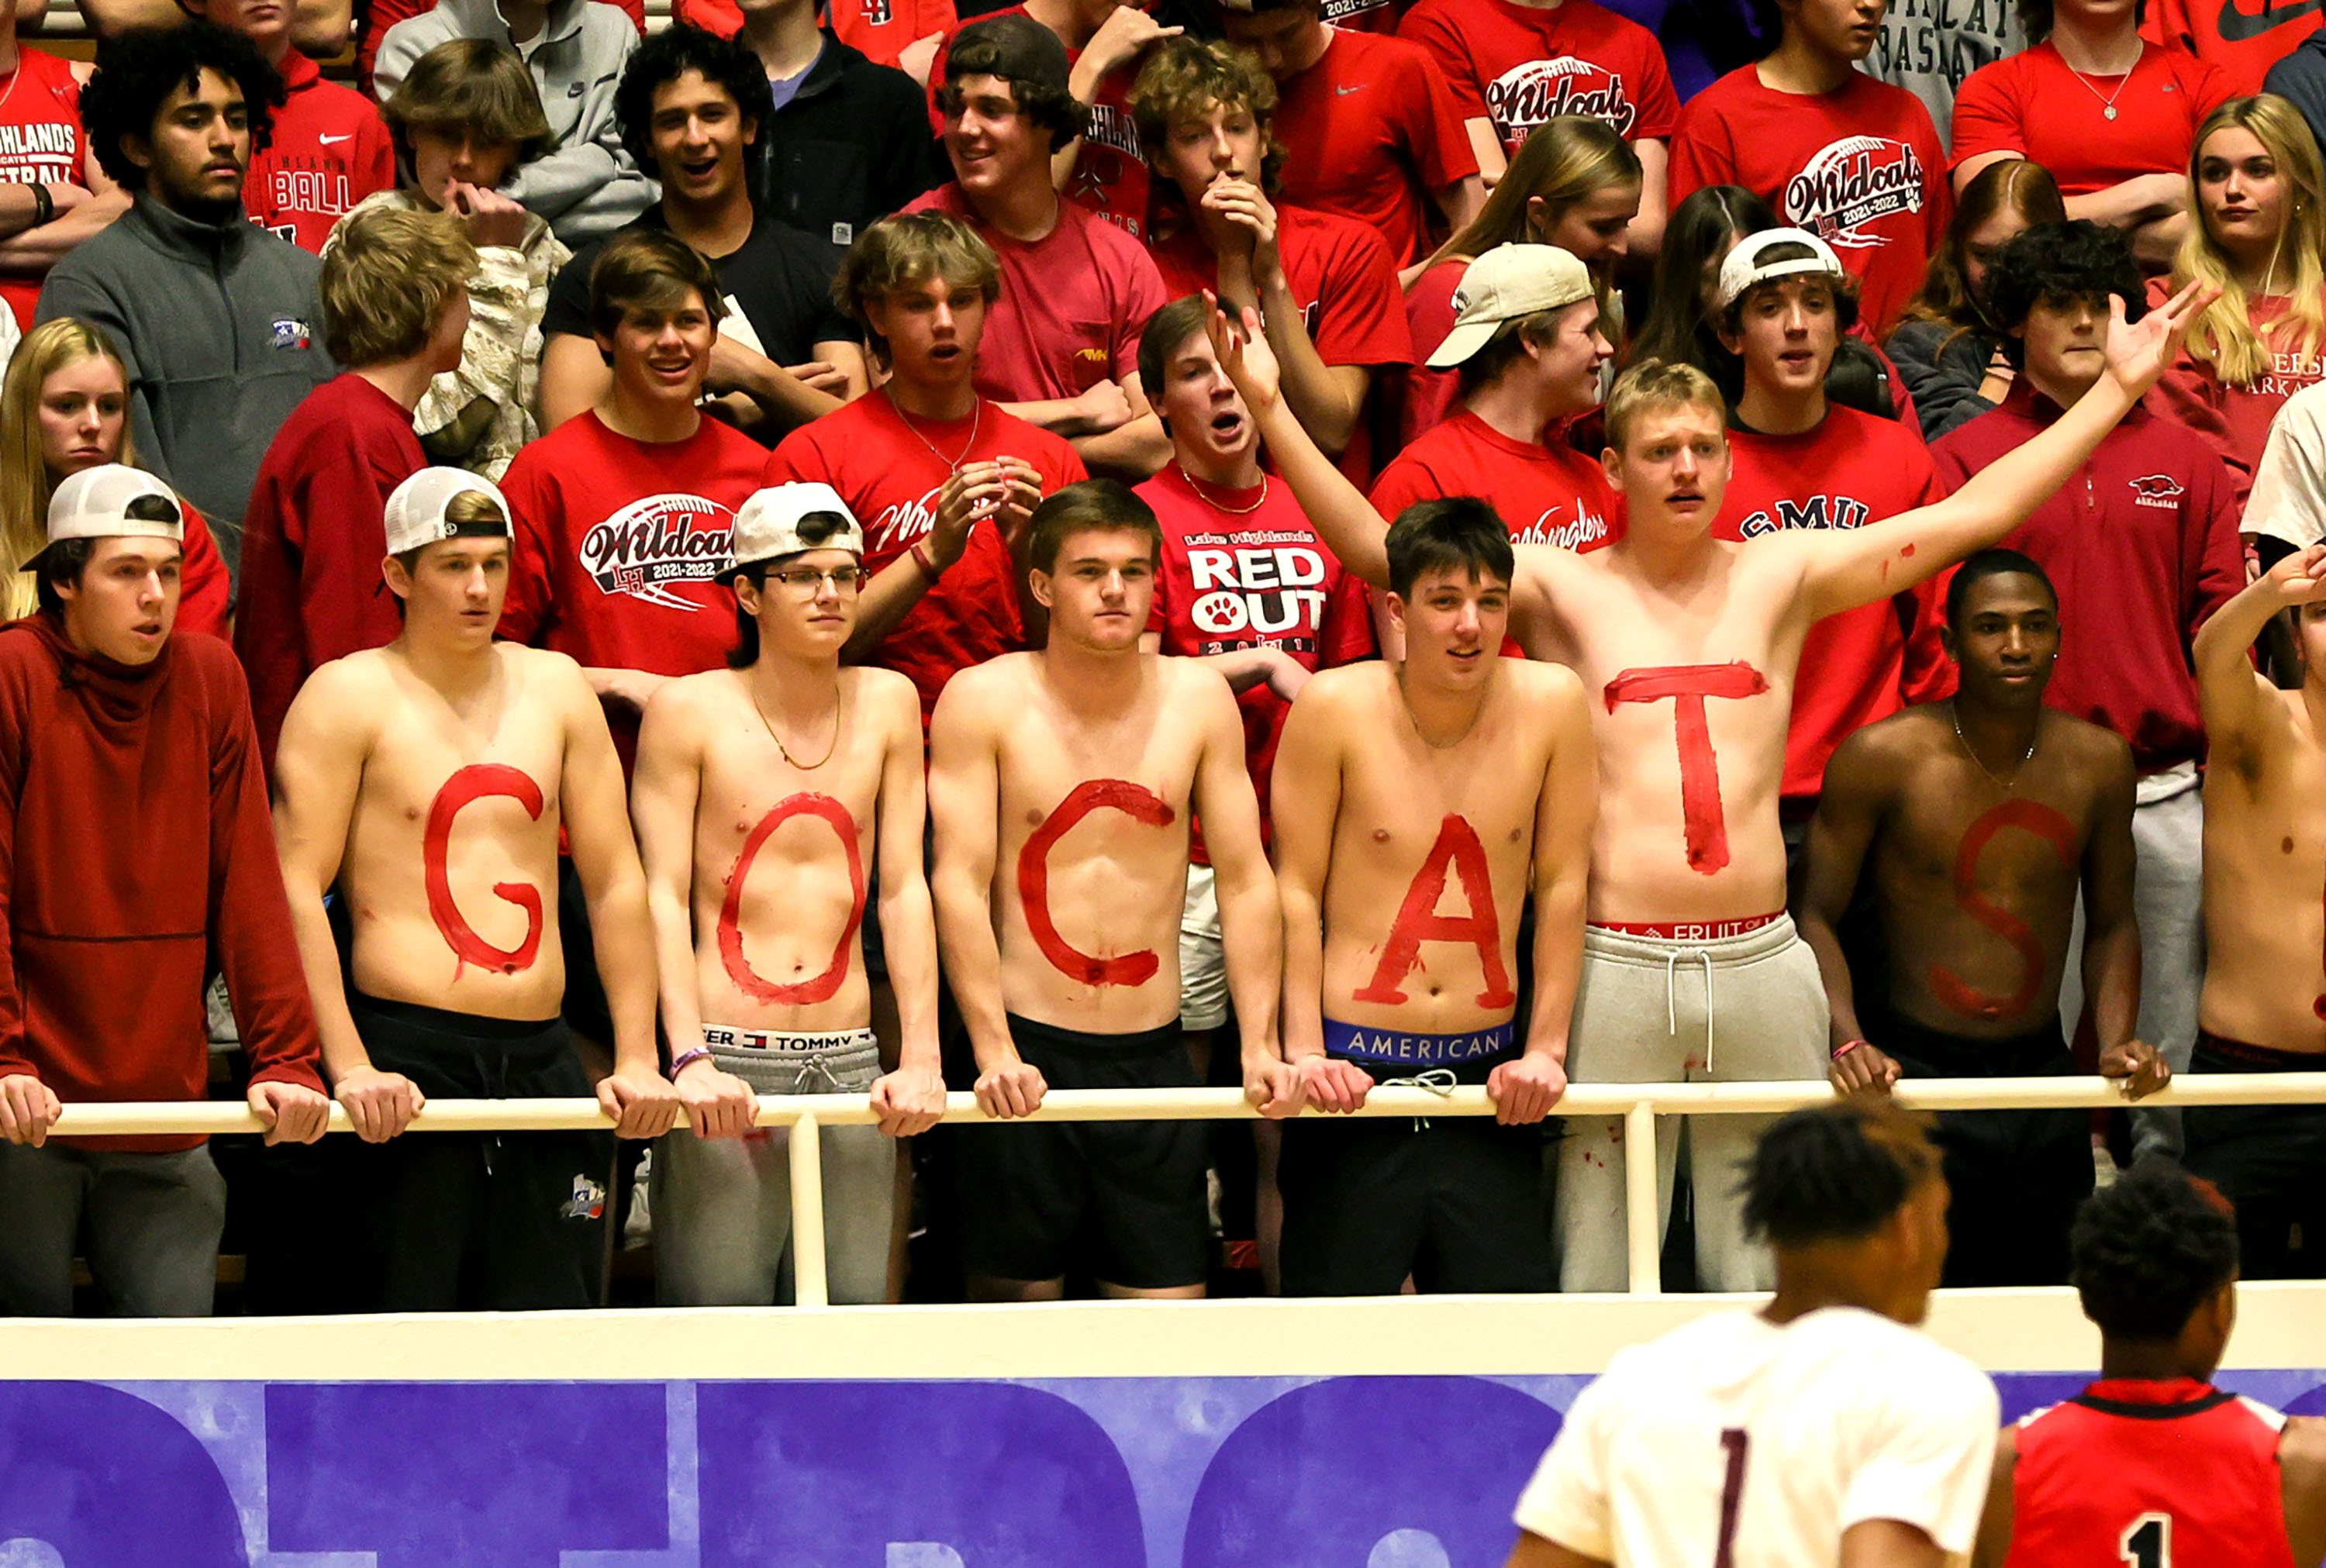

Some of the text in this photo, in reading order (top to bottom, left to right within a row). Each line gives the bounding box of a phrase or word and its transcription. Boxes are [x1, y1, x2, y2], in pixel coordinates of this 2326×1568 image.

[1488, 74, 1629, 122] Wildcats
[0, 123, 75, 153] HLANDS
[1788, 143, 1923, 223] Wildcats
[1843, 195, 1900, 225] 2021-2022
[2273, 353, 2326, 377] ERS
[2246, 377, 2313, 398] ARKA
[1739, 495, 1869, 540] SMU
[584, 515, 737, 574] Wildca
[1184, 531, 1315, 546] Lake Highlands
[611, 565, 647, 594] LH
[1187, 547, 1325, 589] RED
[1192, 589, 1327, 633] OUT
[776, 1036, 851, 1051] TOMMY
[1348, 1032, 1499, 1059] AMERICAN
